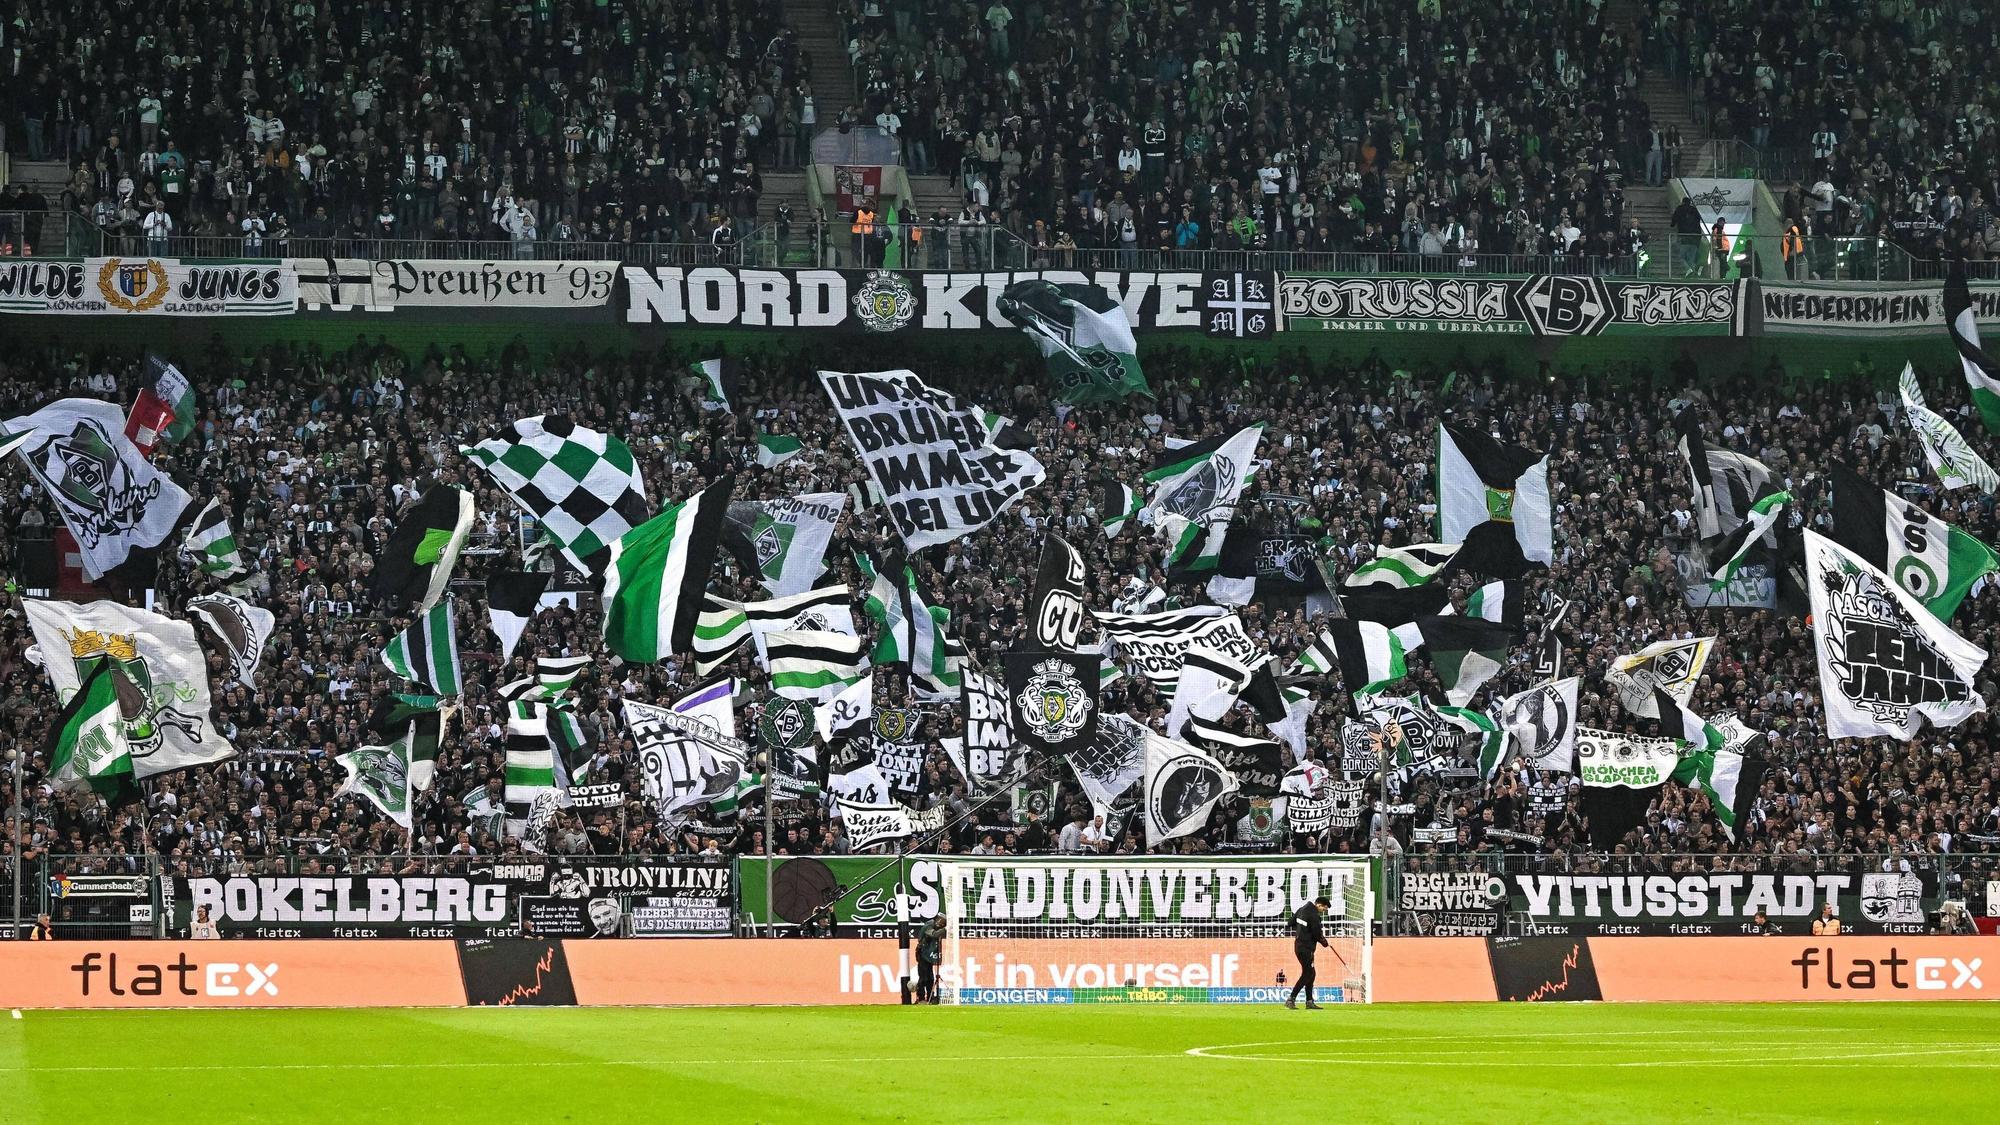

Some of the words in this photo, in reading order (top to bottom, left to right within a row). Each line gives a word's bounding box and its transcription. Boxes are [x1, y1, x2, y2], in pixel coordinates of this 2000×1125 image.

[0, 263, 85, 298] WILDE
[179, 267, 281, 300] JUNGS
[623, 266, 848, 326] NORD
[923, 271, 1202, 329] KUVE
[1280, 279, 1508, 322] BORUSSIA
[1619, 285, 1735, 325] FANS
[164, 302, 226, 312] GLADBACH
[1764, 292, 1930, 323] NIEDERRHEIN
[1322, 321, 1385, 331] IMMER
[1396, 321, 1428, 332] UND
[1438, 321, 1523, 333] ÜBERALL!
[890, 497, 948, 539] BEI
[1582, 764, 1656, 777] MÖNCHEN
[1582, 773, 1659, 786] GLADBACH
[569, 783, 621, 796] SOTTO
[571, 792, 625, 808] ULTURA
[494, 865, 545, 879] BANDA
[586, 866, 730, 889] FRONTLINE
[71, 881, 132, 891] Gummersbach
[910, 861, 1354, 919] STADIONVERBOT
[1402, 873, 1489, 891] BEGLEIT
[188, 873, 507, 922] BÖKELBERG
[699, 888, 729, 898] 2006
[1401, 890, 1487, 910] SERVICE
[1516, 875, 1851, 917] VITUSSTADT
[647, 898, 670, 907] WIR
[672, 898, 716, 908] WOLLEN
[131, 909, 151, 917] 17/2
[633, 908, 675, 919] LIEBER
[633, 919, 654, 931] ALS
[655, 919, 730, 931] DISKUTIEREN
[994, 953, 1035, 989] in
[1048, 953, 1240, 989] yourself
[973, 990, 1048, 1003] JONGEN
